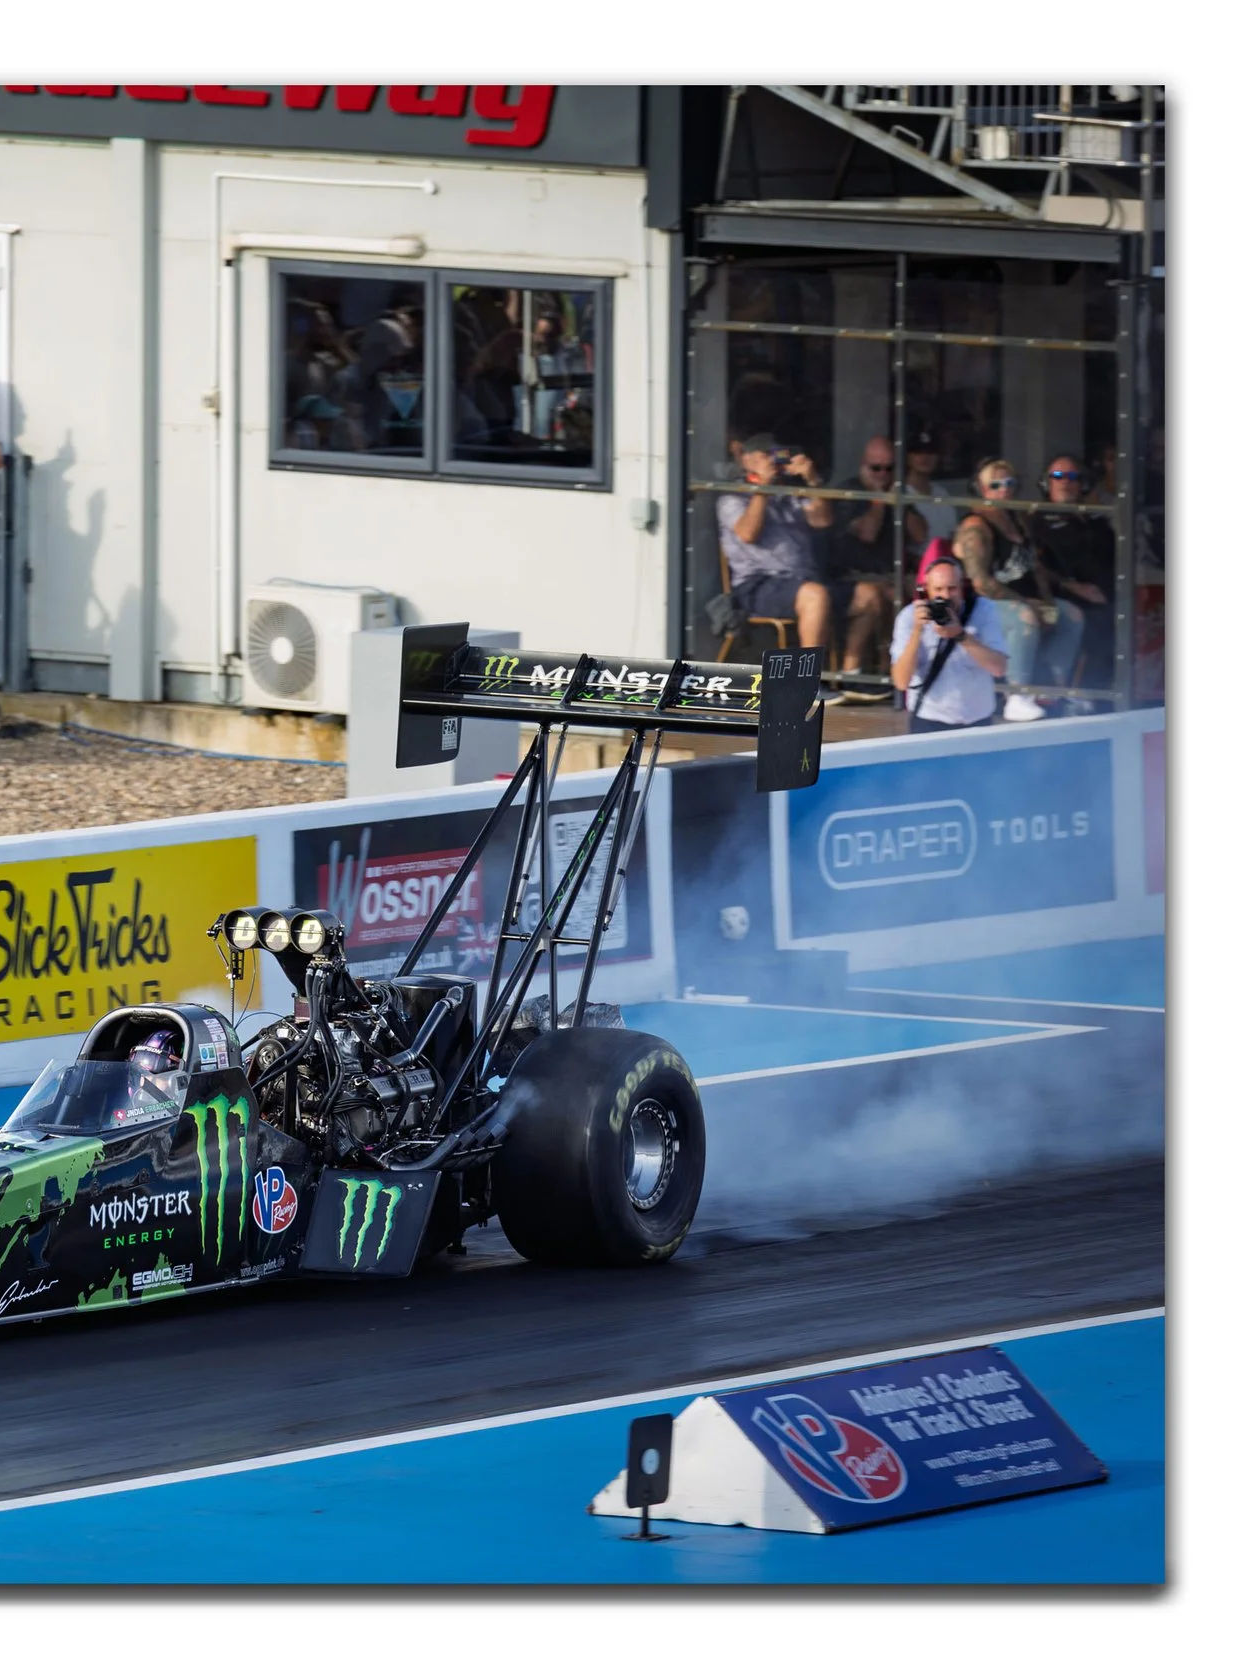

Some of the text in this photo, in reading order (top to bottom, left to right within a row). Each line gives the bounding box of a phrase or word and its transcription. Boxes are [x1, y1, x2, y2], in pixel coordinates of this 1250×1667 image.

[769, 653, 816, 679] TF 11
[832, 811, 1090, 869] DRAPER TOOLS
[254, 1166, 285, 1231] VP
[273, 1200, 297, 1225] Racing
[104, 1228, 175, 1249] ENERGY
[132, 1263, 193, 1286] EGMO.CH
[906, 1405, 970, 1436] Track
[968, 1394, 1036, 1425] Street
[752, 1393, 872, 1500] VP
